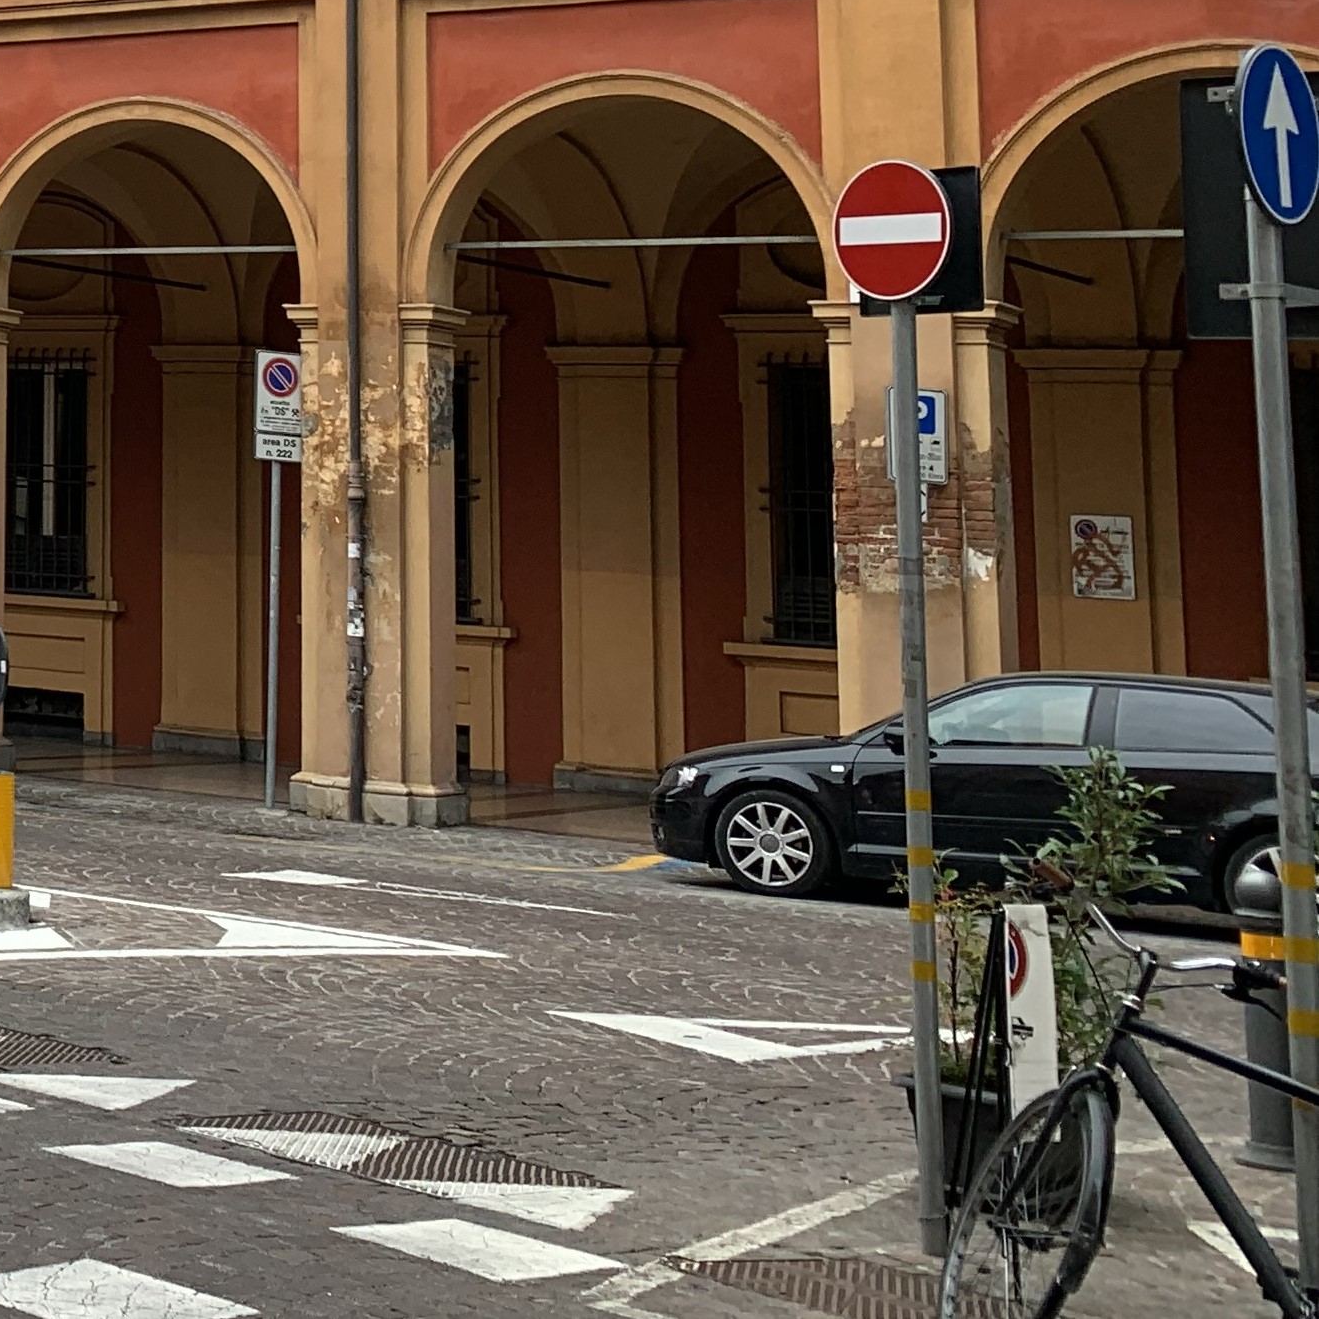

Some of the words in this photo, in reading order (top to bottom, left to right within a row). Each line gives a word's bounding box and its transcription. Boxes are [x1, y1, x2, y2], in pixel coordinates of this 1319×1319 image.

[262, 438, 281, 447] area
[283, 438, 297, 448] DS
[276, 448, 293, 459] 222
